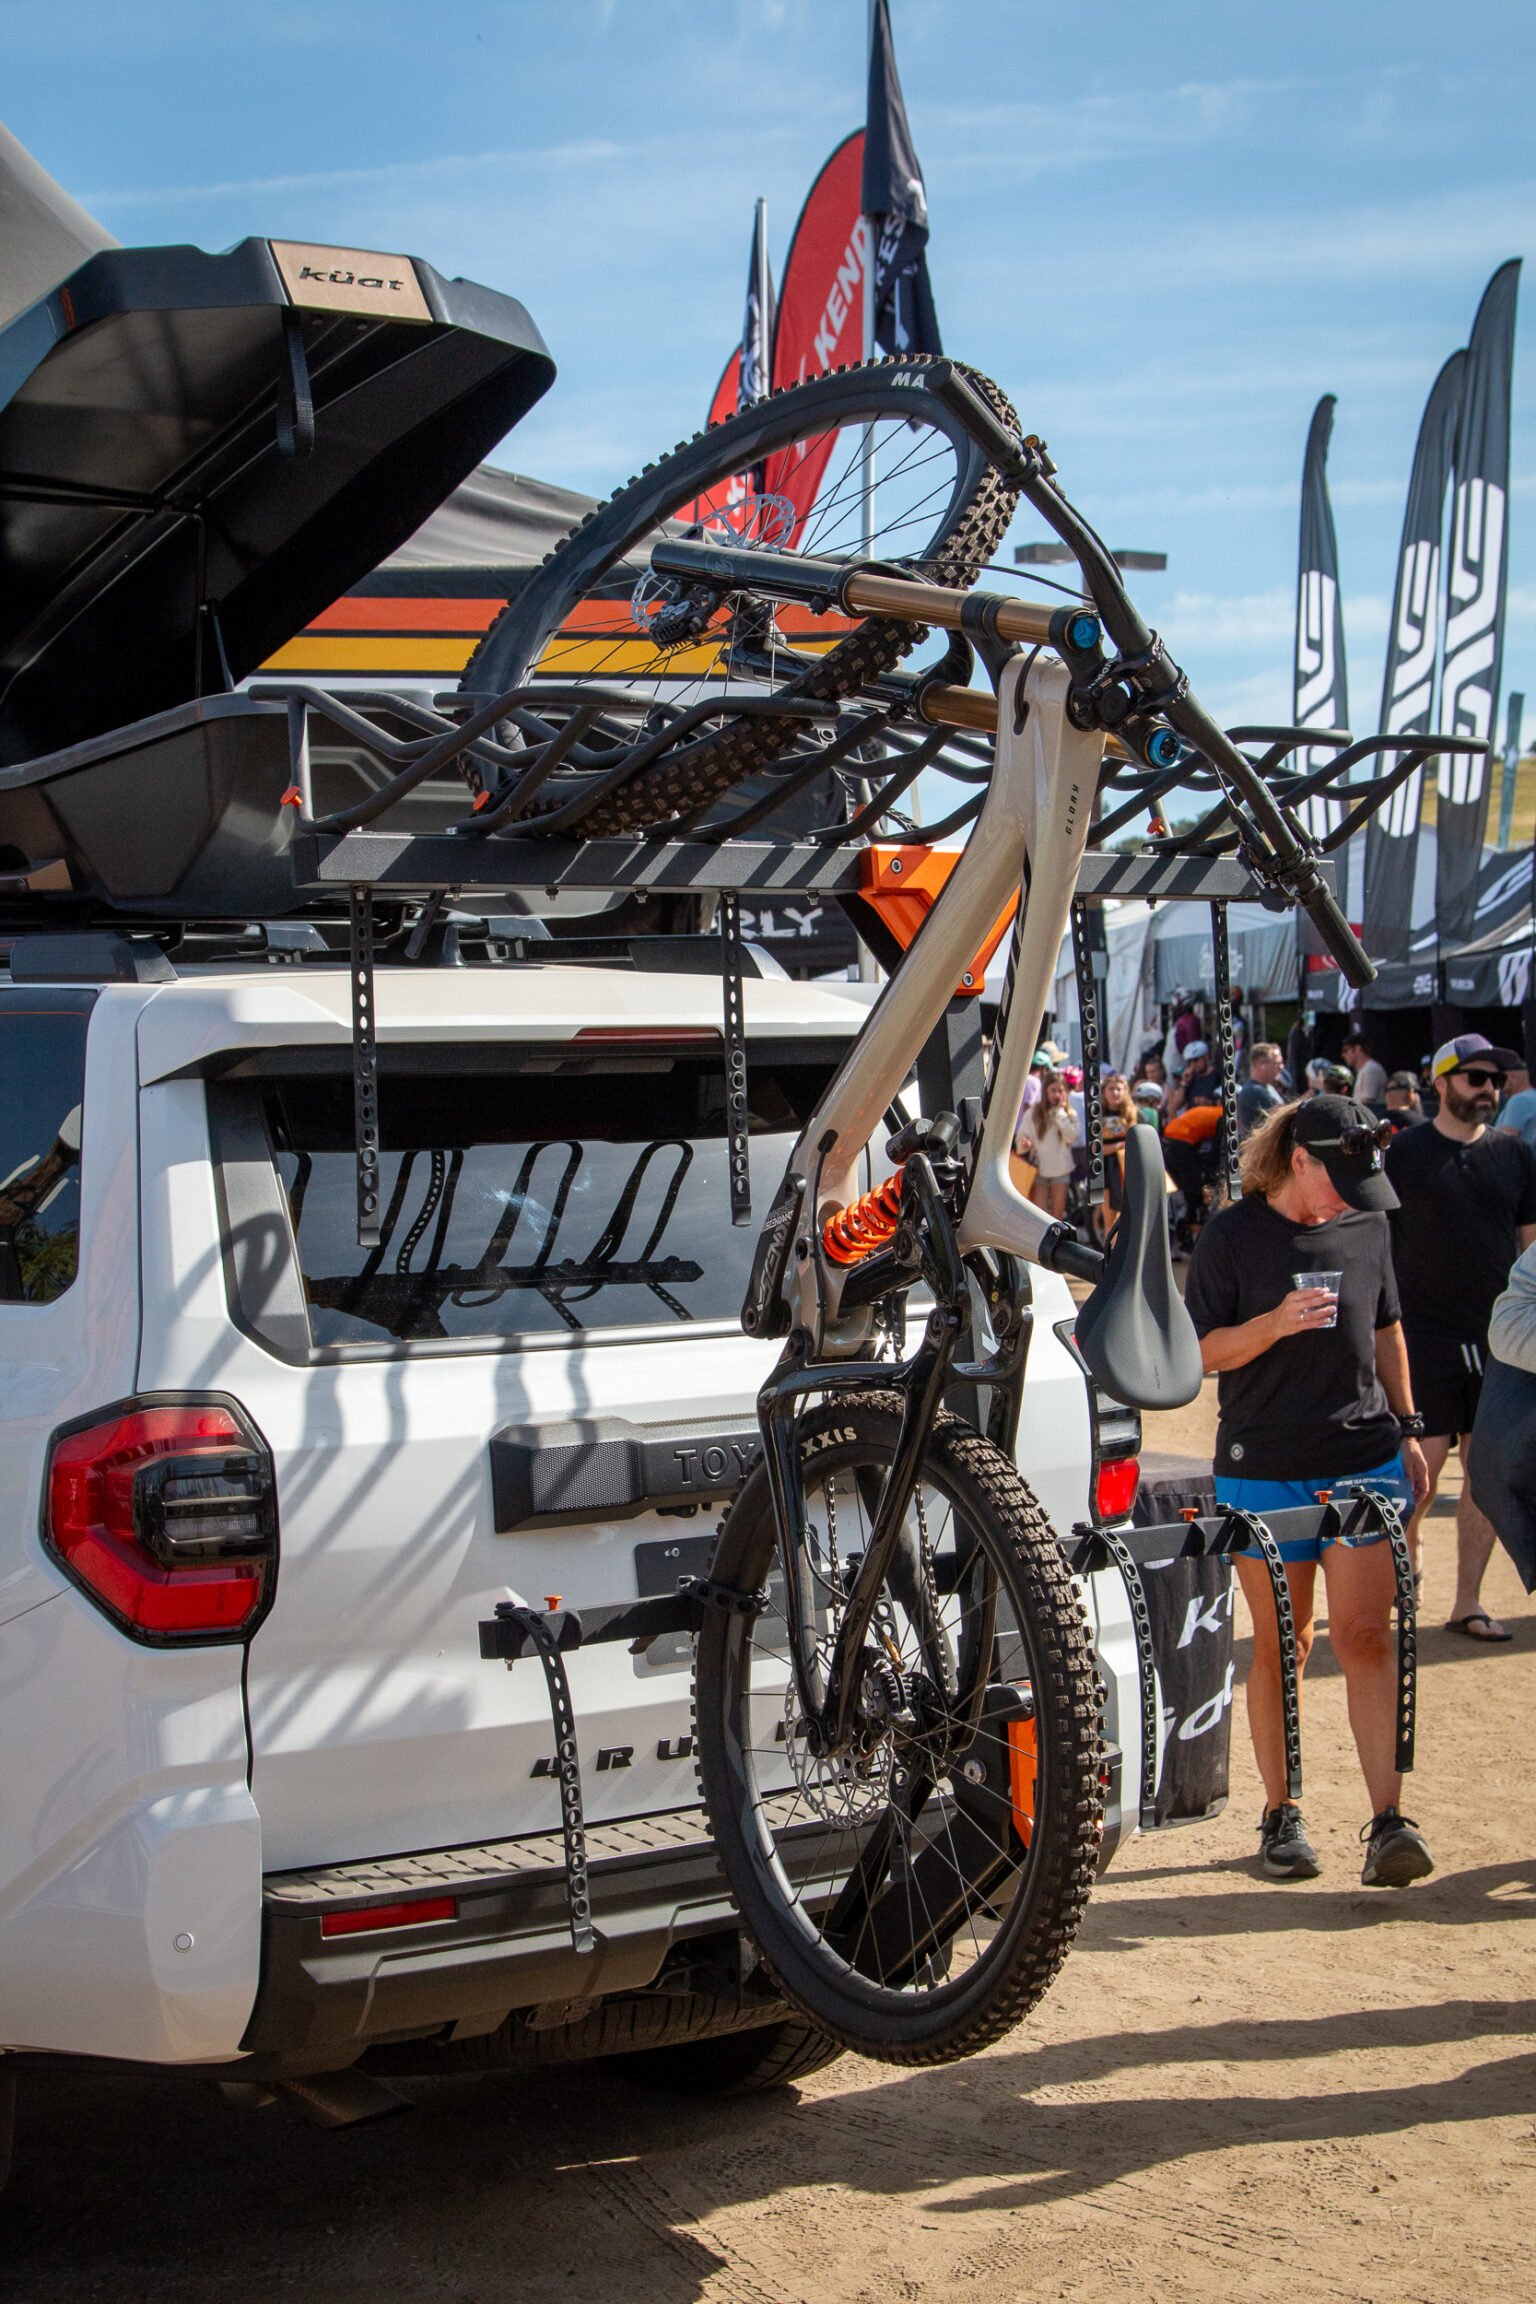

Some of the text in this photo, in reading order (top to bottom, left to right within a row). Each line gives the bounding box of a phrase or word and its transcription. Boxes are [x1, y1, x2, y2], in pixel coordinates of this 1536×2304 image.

[299, 266, 404, 291] küat
[1065, 783, 1079, 836] GLORY
[800, 1426, 857, 1461] XXIS
[673, 1442, 755, 1485] TOY
